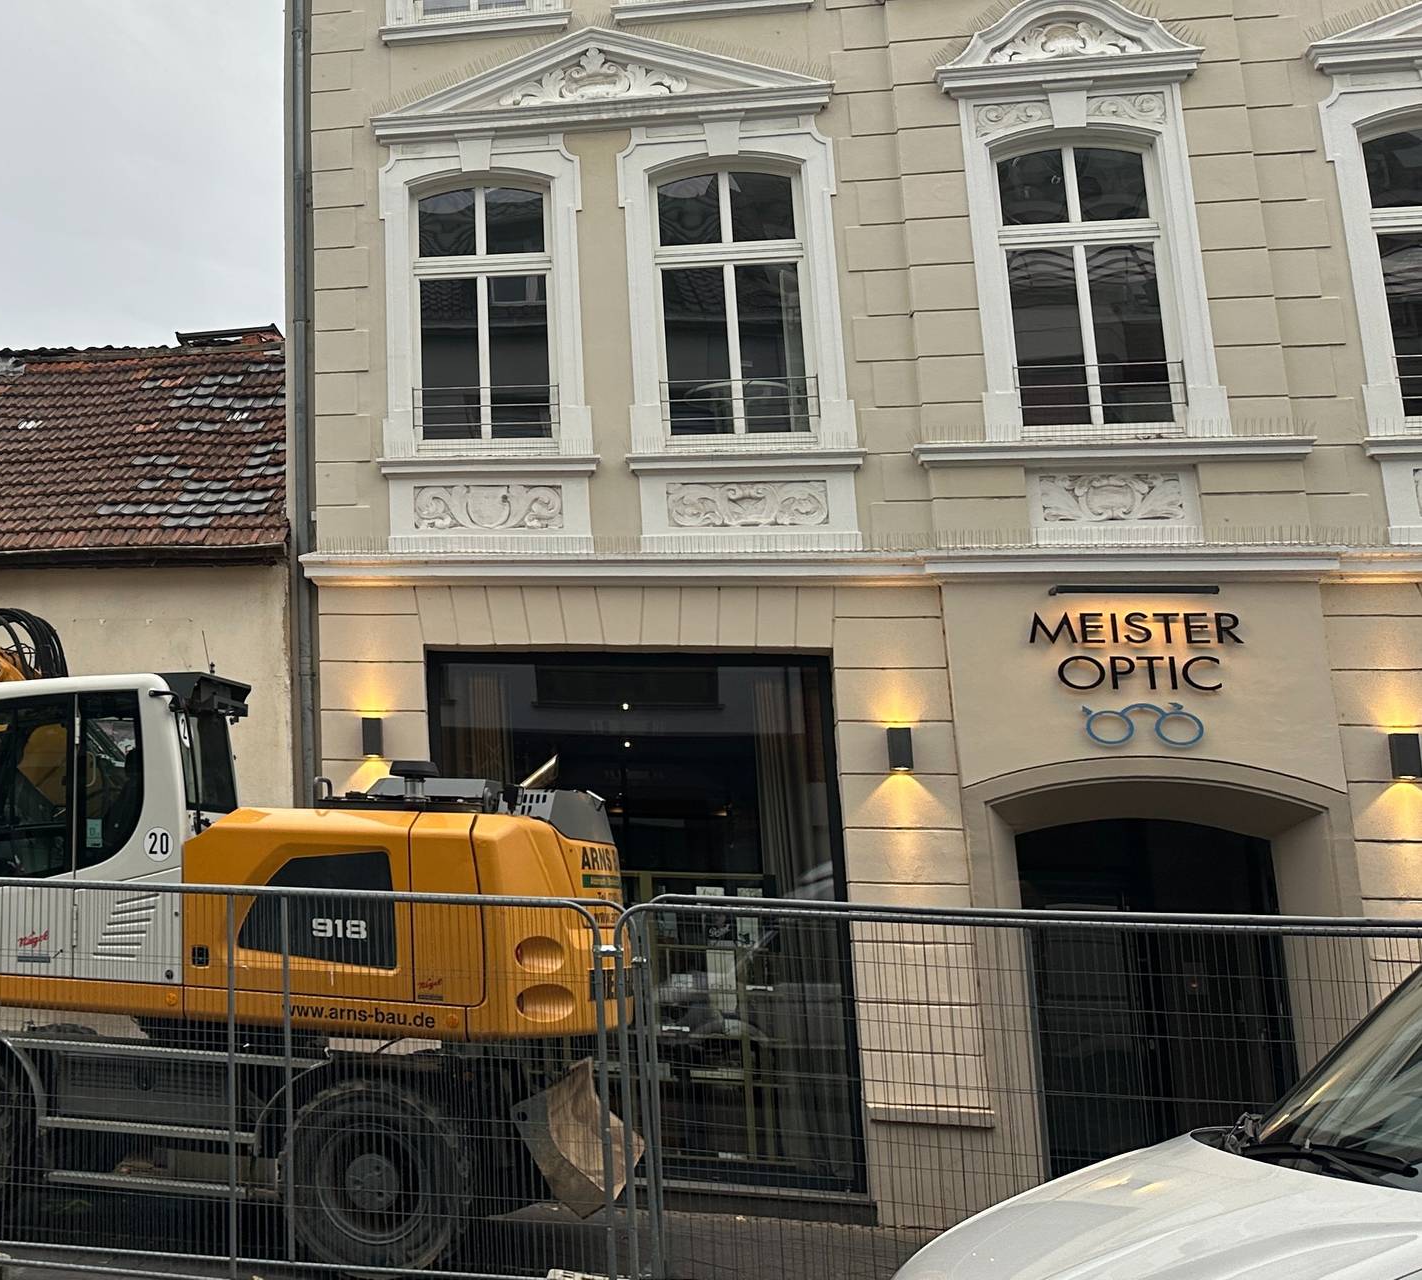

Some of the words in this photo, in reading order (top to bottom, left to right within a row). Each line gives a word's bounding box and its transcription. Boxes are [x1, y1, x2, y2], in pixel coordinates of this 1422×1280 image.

[1029, 611, 1245, 645] MEISTER
[1057, 655, 1223, 691] OPTIC
[148, 832, 169, 855] 20
[582, 847, 613, 871] ARNS
[312, 918, 367, 939] 918
